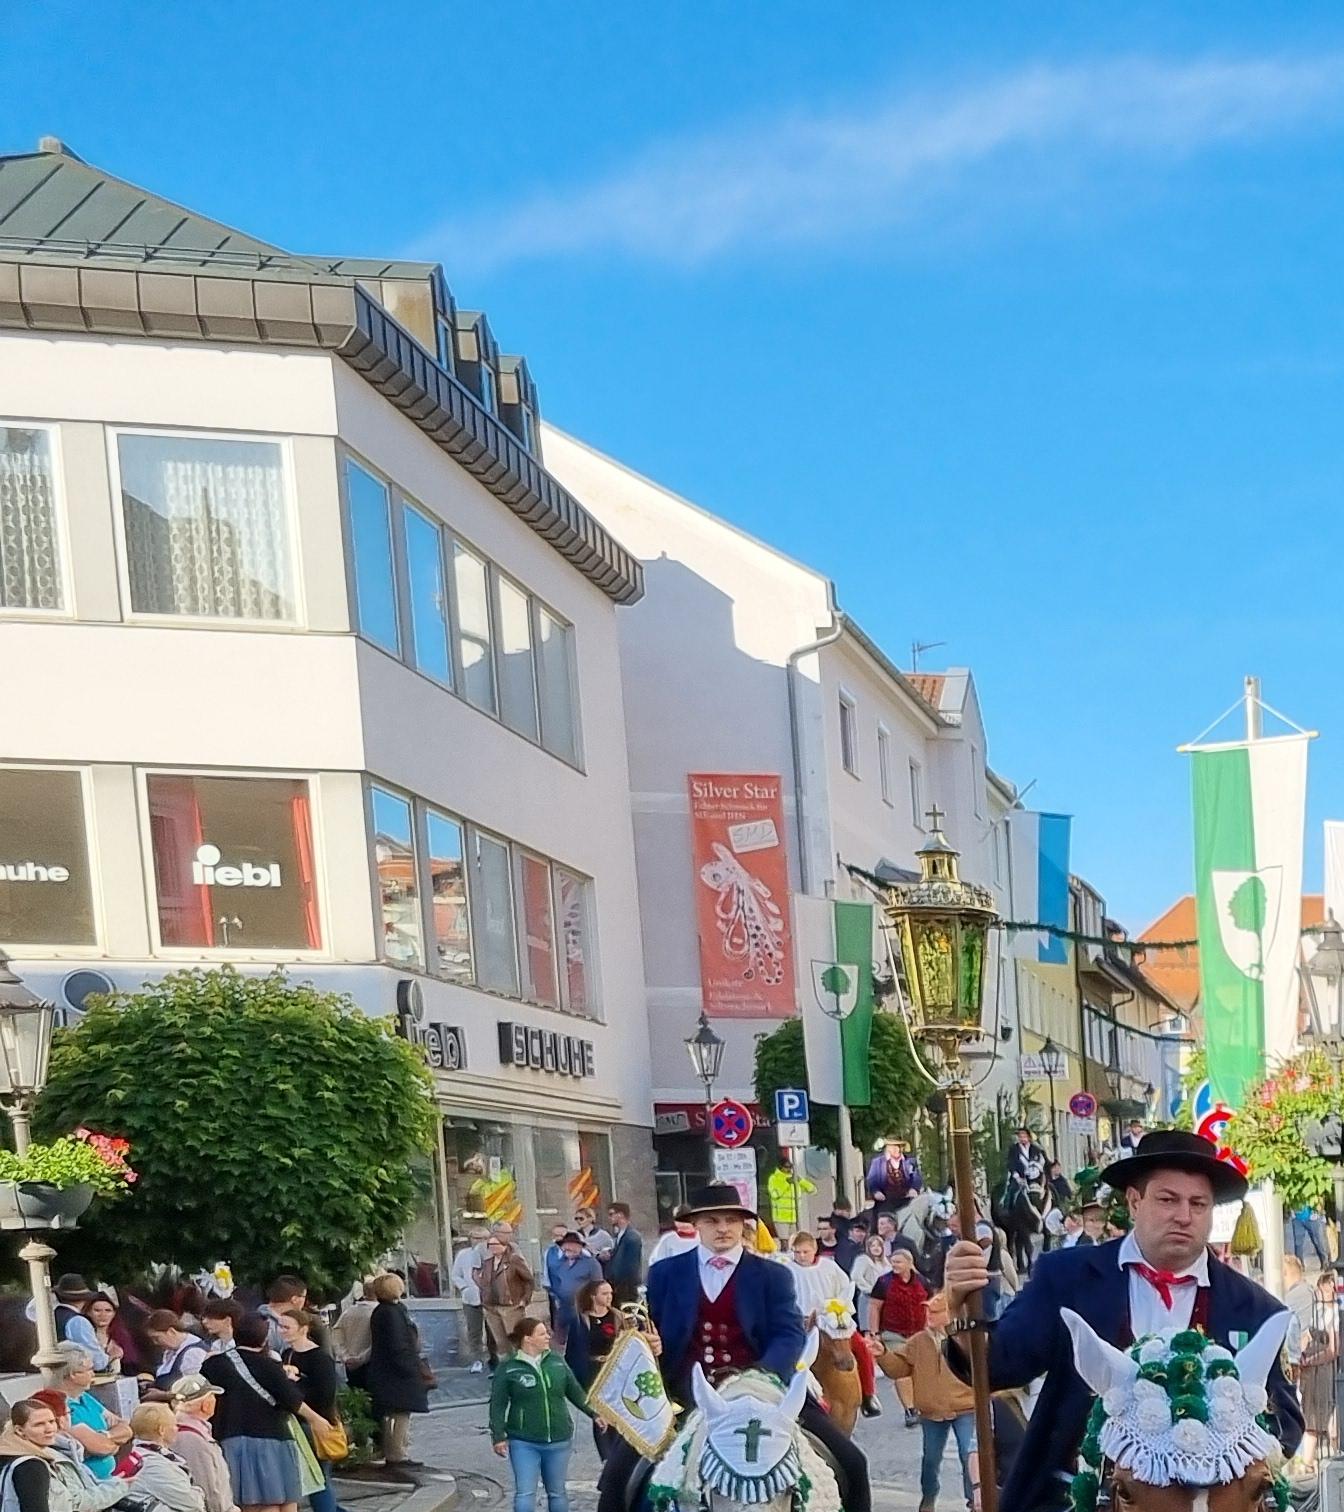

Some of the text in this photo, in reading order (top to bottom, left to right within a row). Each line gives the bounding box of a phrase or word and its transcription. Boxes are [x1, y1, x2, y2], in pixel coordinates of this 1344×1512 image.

[692, 782, 777, 799] Silver Star
[0, 862, 70, 882] uhe
[193, 844, 282, 887] liebl
[506, 1021, 597, 1079] SCHUHE
[783, 1094, 800, 1118] P
